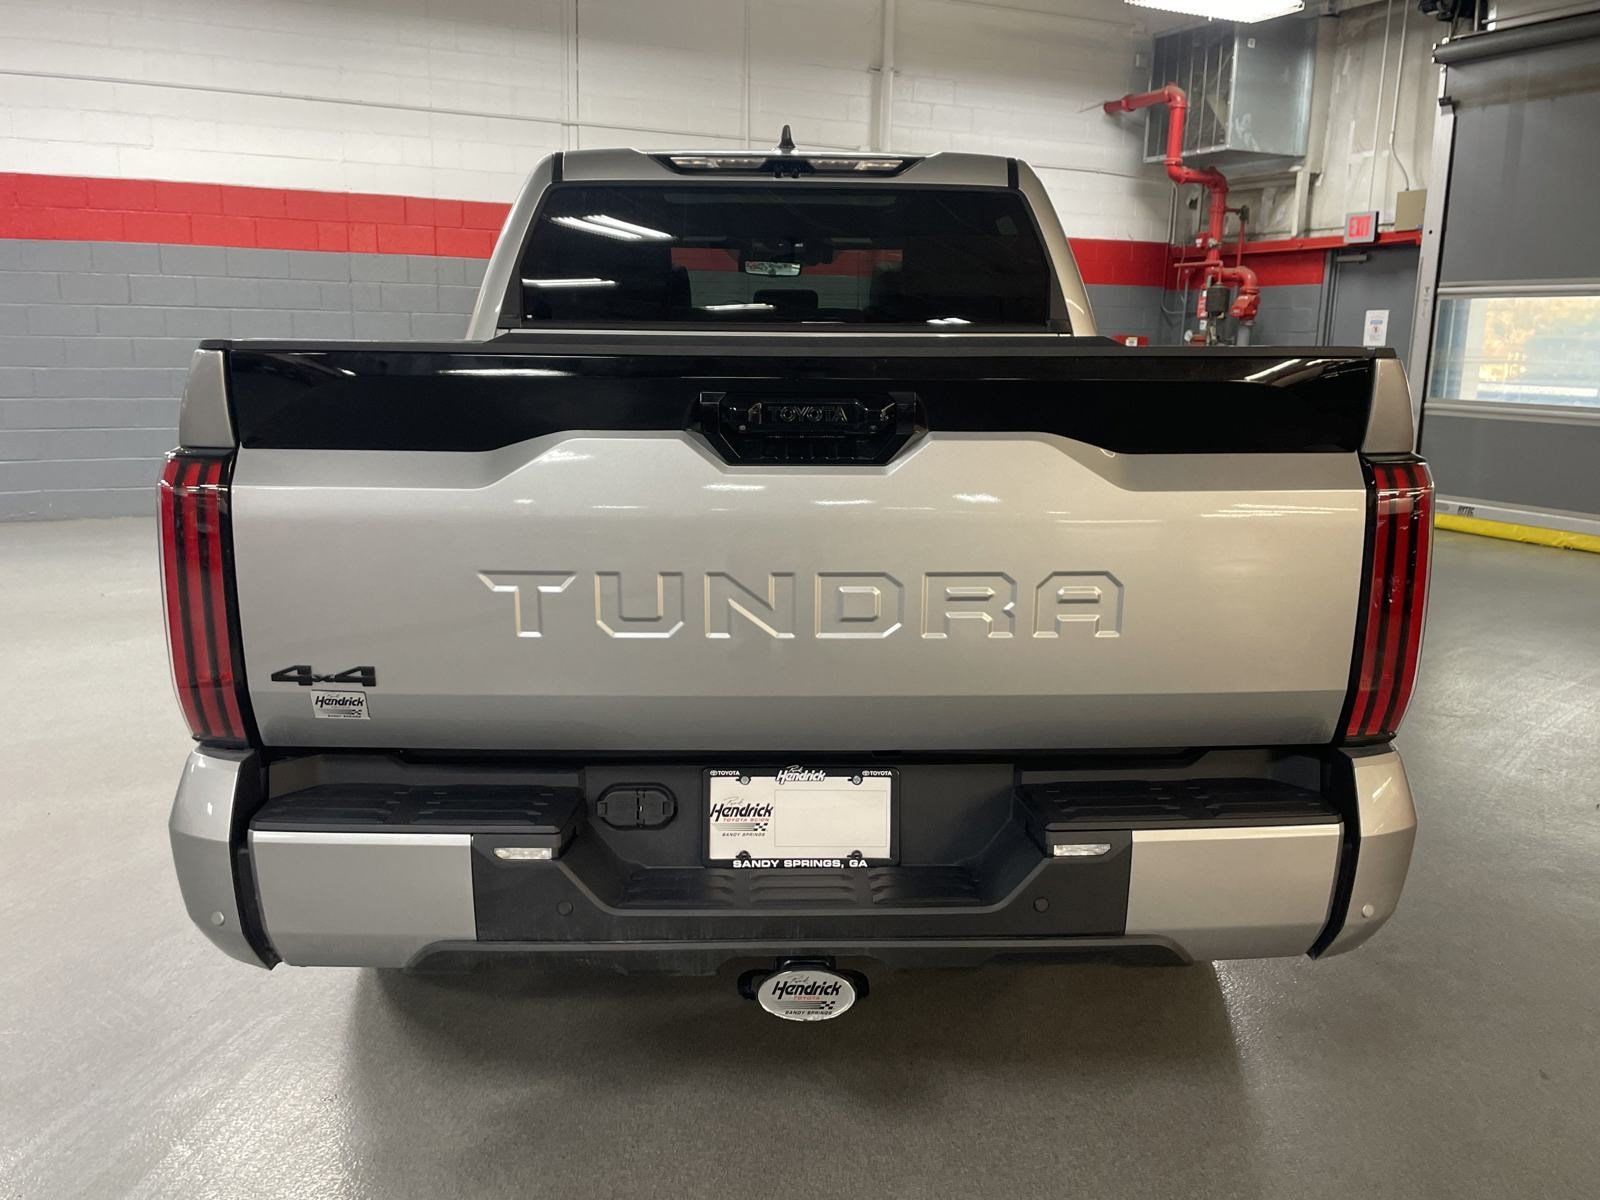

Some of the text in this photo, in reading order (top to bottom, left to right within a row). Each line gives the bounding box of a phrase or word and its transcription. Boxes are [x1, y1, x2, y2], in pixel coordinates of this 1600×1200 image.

[768, 405, 848, 422] TOYOTA
[477, 570, 1124, 639] TUNDRA
[314, 695, 364, 708] Hendrick
[776, 769, 826, 785] Hendrick
[710, 803, 773, 822] Hendrick
[733, 860, 868, 869] SANDY SPRINGS, GA
[772, 981, 842, 1000] Hendrick
